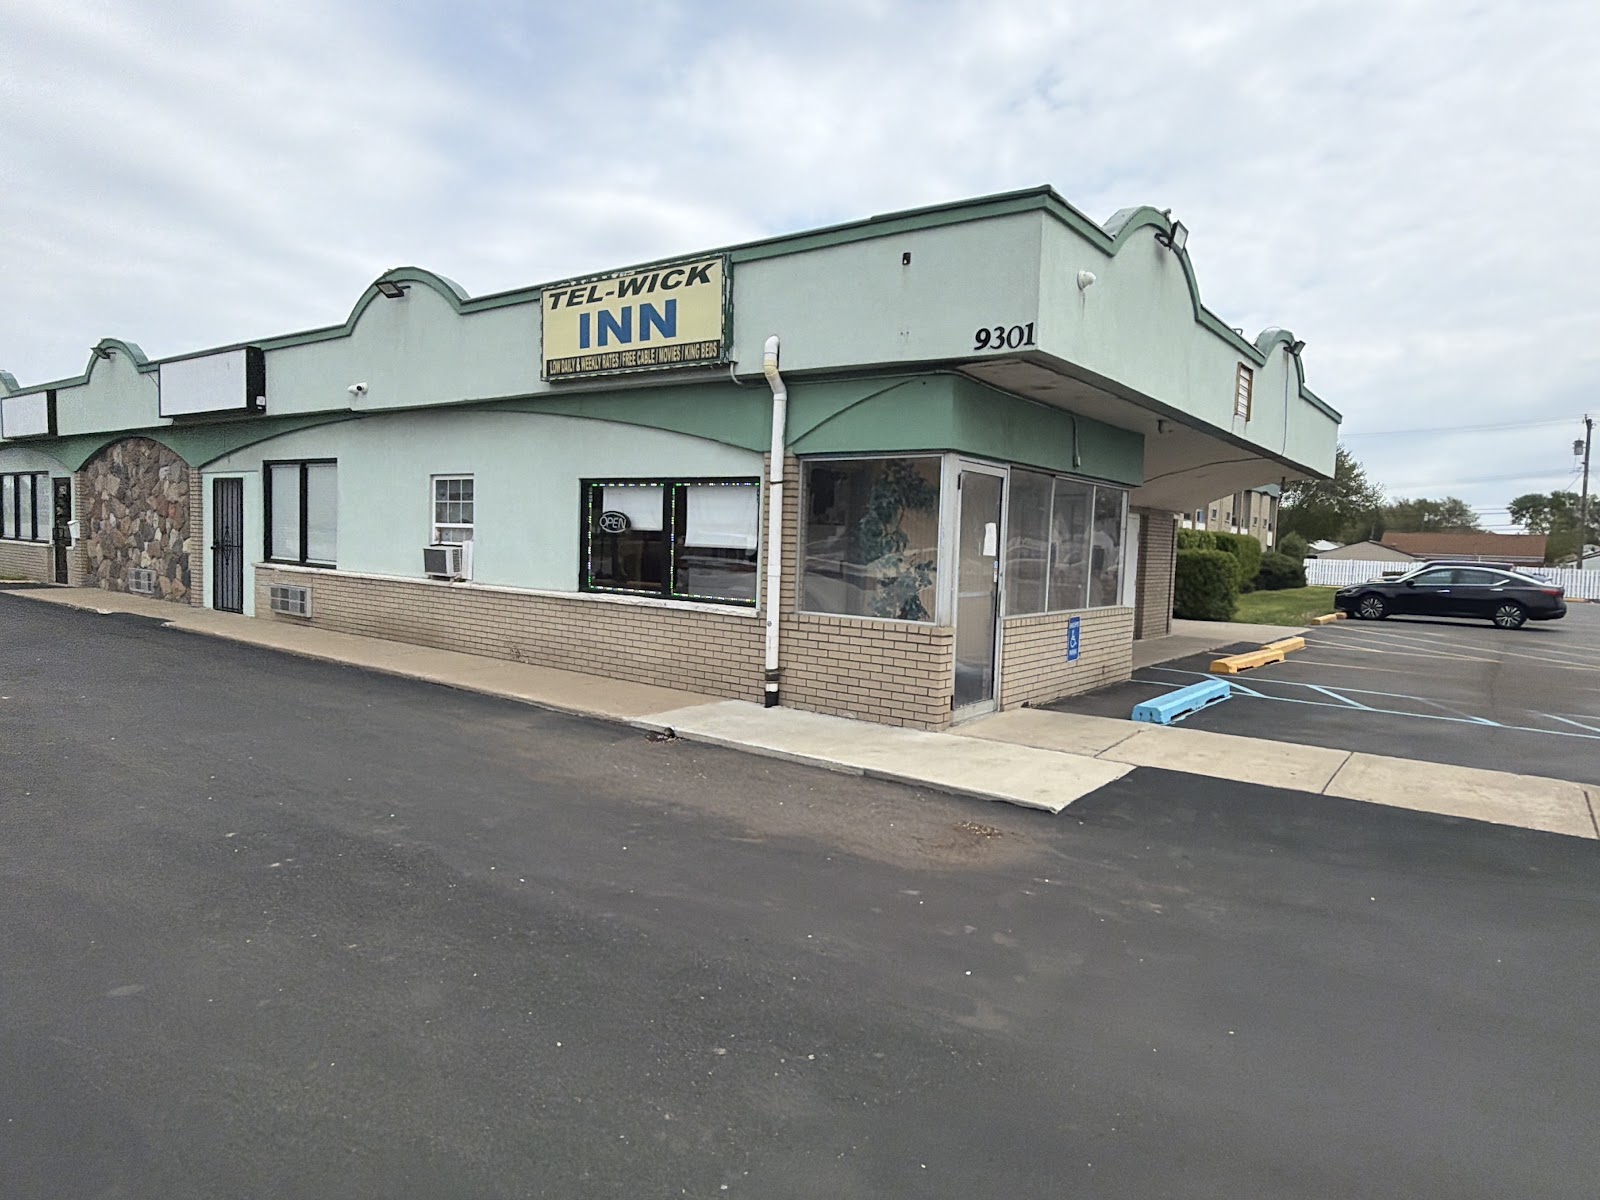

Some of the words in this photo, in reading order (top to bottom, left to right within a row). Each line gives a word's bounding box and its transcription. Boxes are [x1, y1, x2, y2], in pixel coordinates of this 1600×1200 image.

[548, 262, 718, 310] TEL-WICK
[579, 298, 677, 350] INN
[973, 321, 1036, 351] 9301
[550, 360, 561, 374] LOW
[561, 359, 576, 373] DAILY
[581, 355, 602, 371] WEEKLY
[602, 353, 619, 369] RATES
[622, 351, 637, 366] FREE
[636, 349, 655, 365] CABLE
[659, 345, 681, 363] MOVIES
[684, 343, 700, 360] KING
[700, 341, 718, 358] BEDS
[599, 516, 627, 529] OPEN
